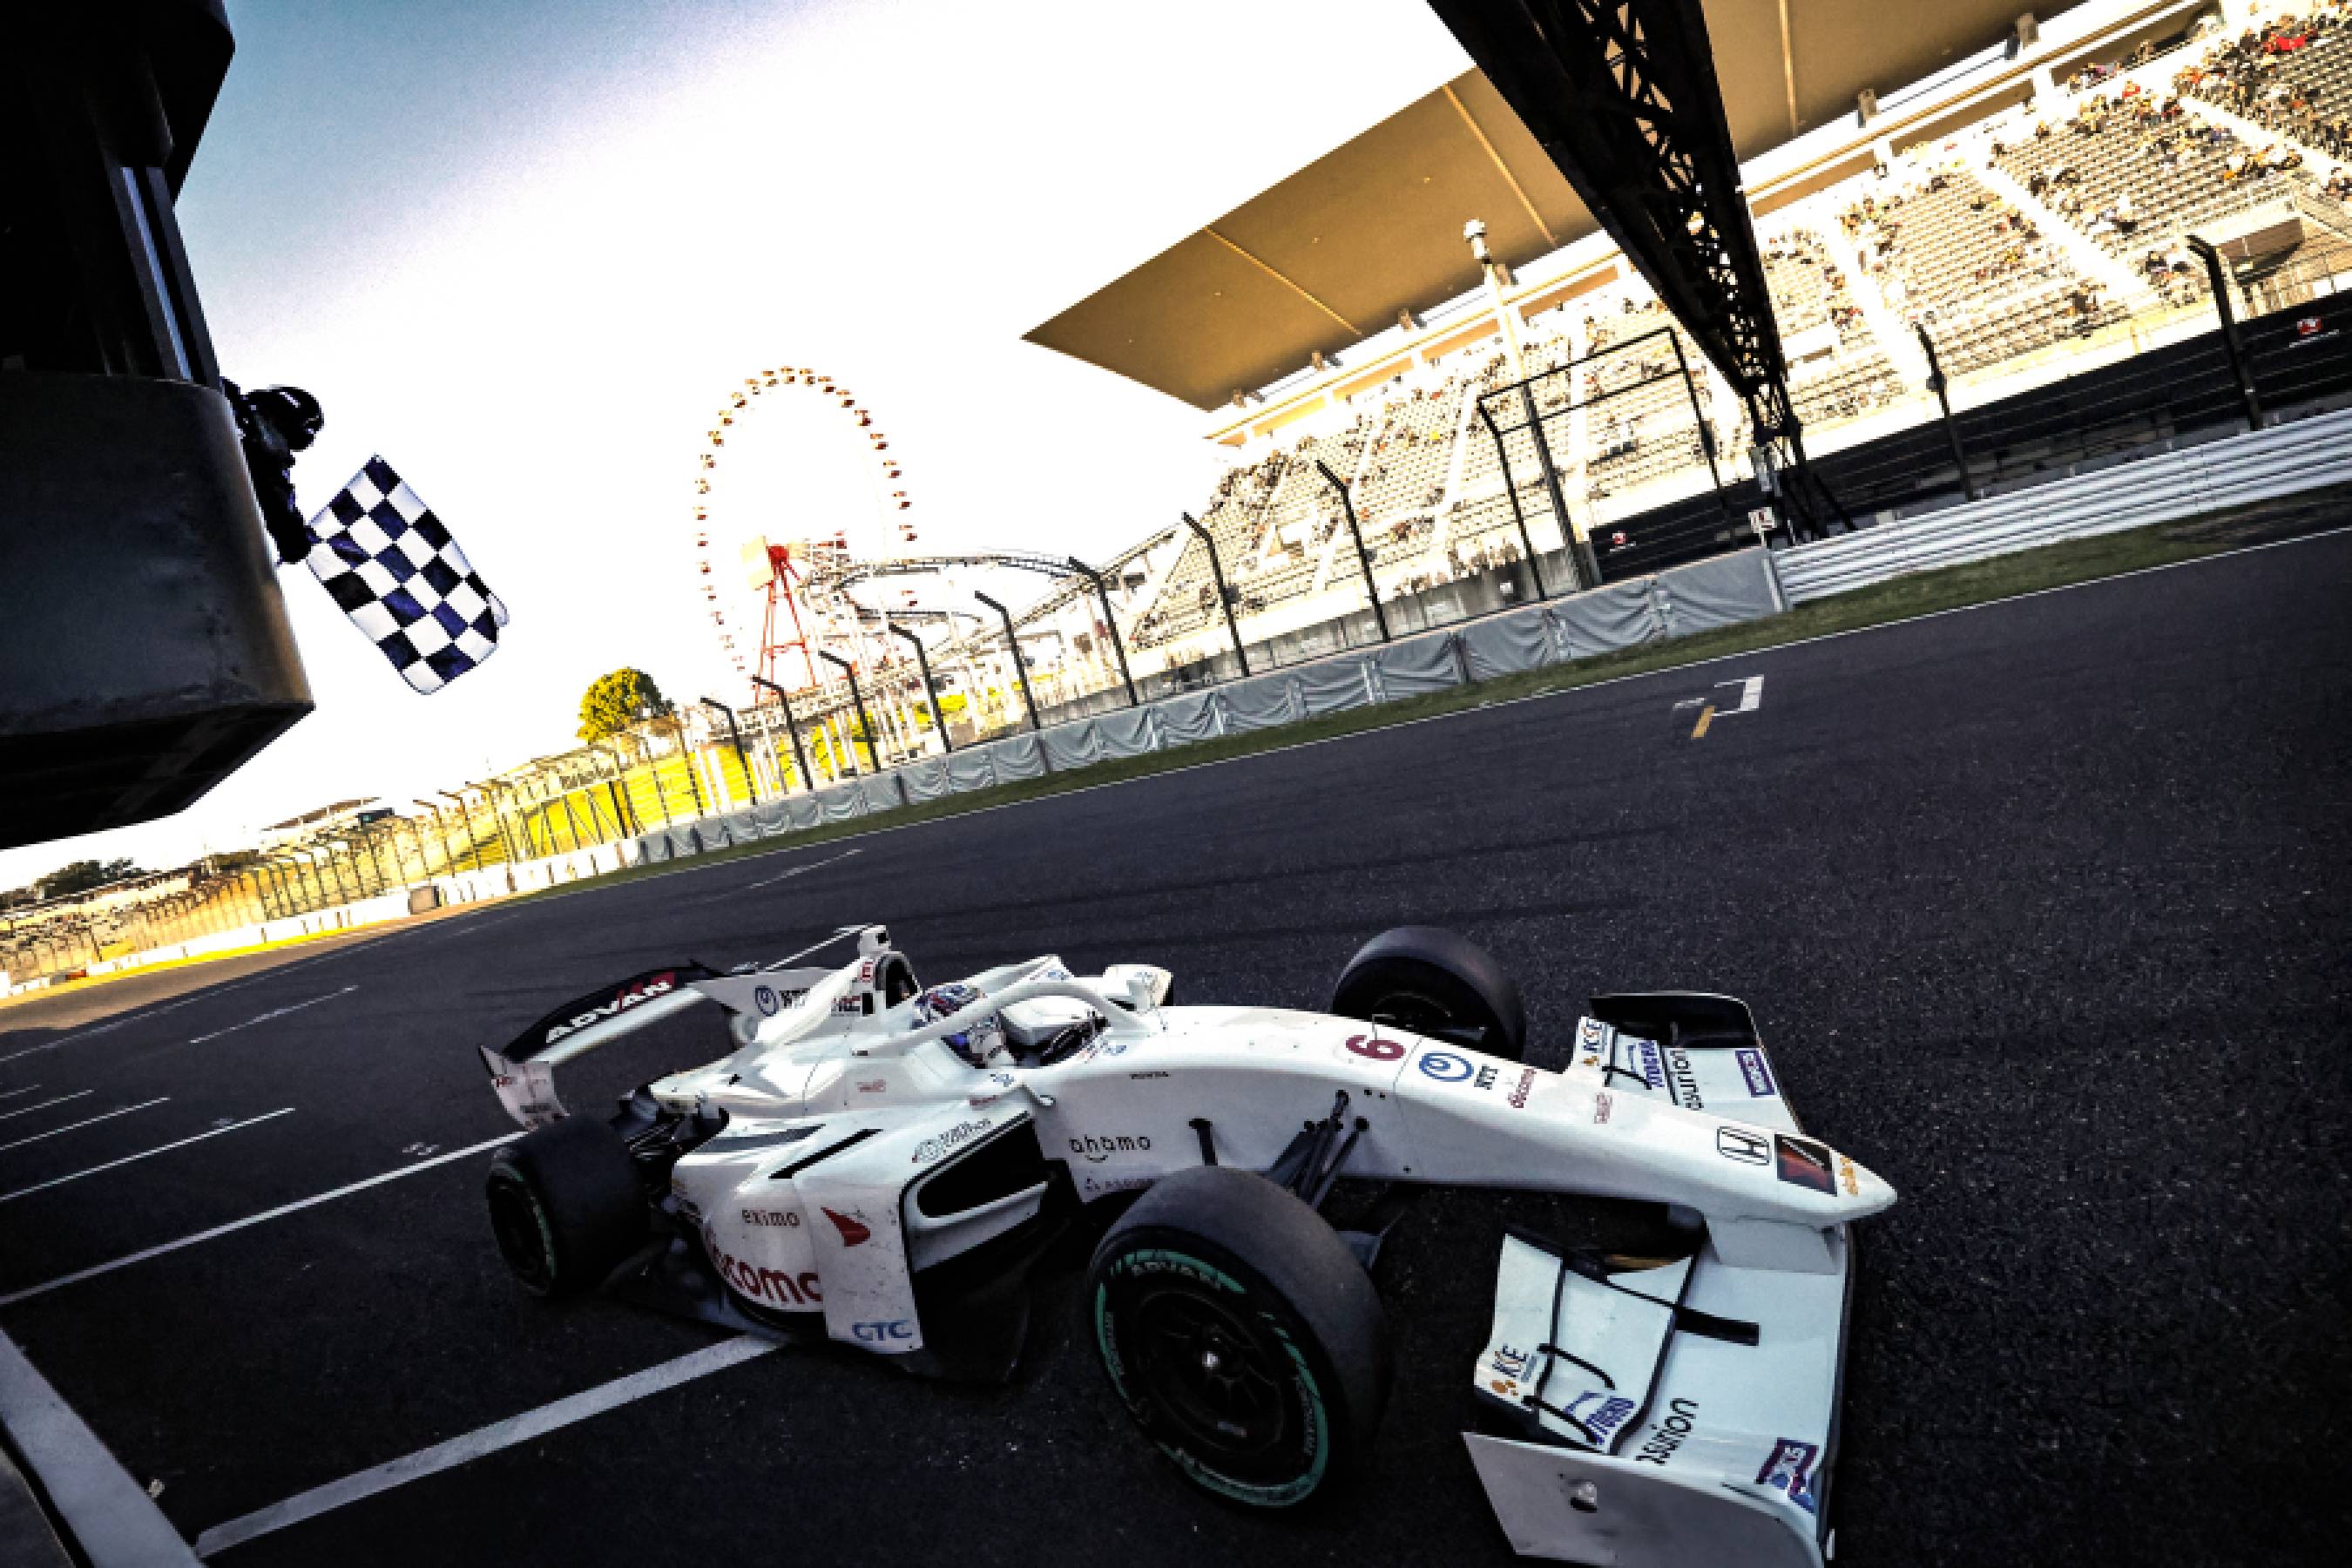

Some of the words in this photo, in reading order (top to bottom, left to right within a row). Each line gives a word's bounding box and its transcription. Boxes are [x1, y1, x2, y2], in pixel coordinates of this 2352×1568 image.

[544, 977, 674, 1044] ADVAN
[1345, 1034, 1406, 1061] 6
[1068, 1135, 1152, 1153] ahamo
[741, 1209, 801, 1228] eximo
[852, 1321, 914, 1342] CTC
